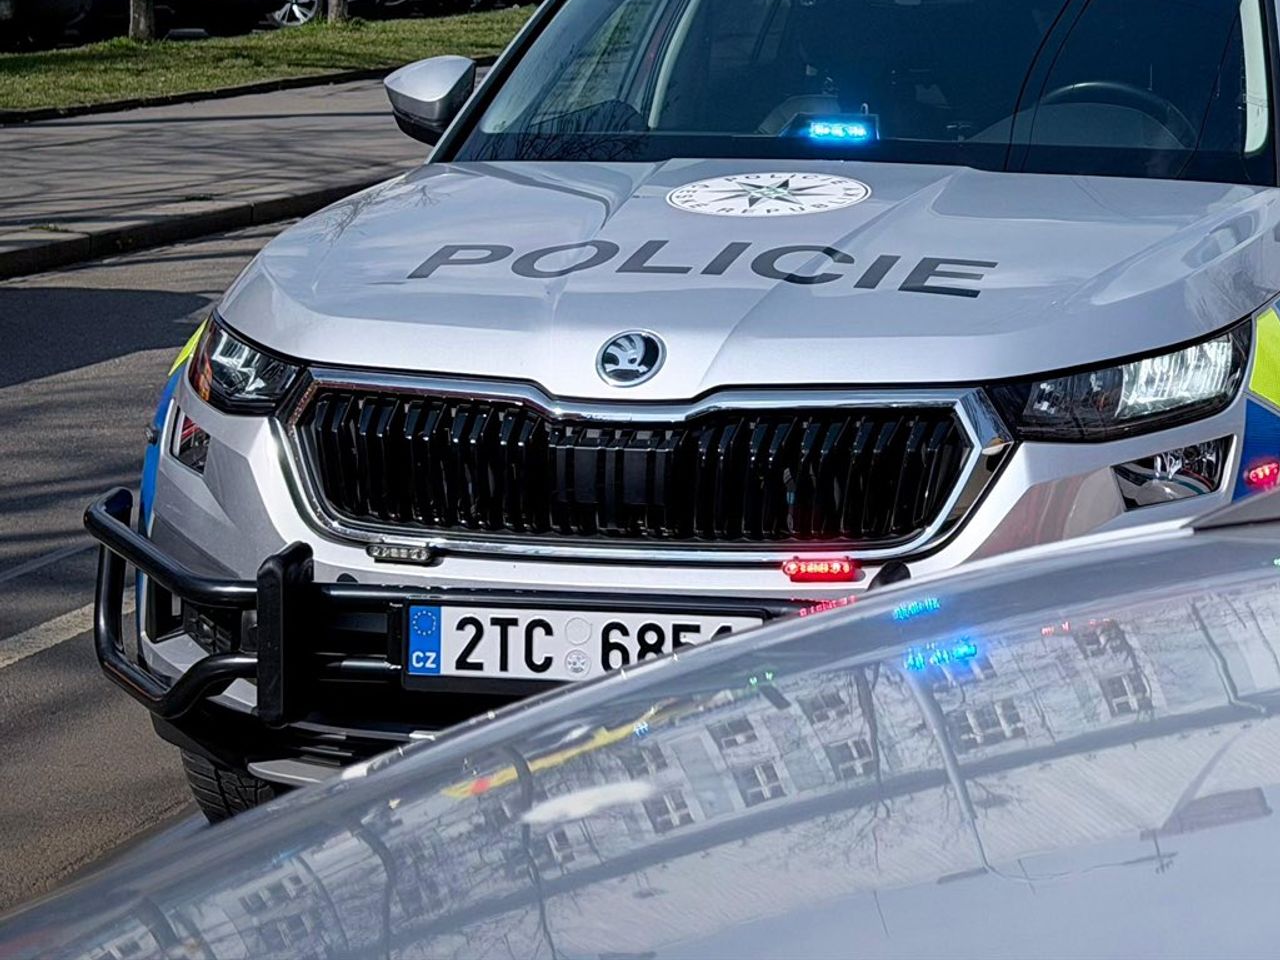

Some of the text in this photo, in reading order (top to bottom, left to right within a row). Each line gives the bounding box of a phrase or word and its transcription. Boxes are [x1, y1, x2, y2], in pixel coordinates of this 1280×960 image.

[406, 239, 999, 299] POLICIE
[411, 650, 437, 669] CZ
[454, 616, 554, 673] 2TC
